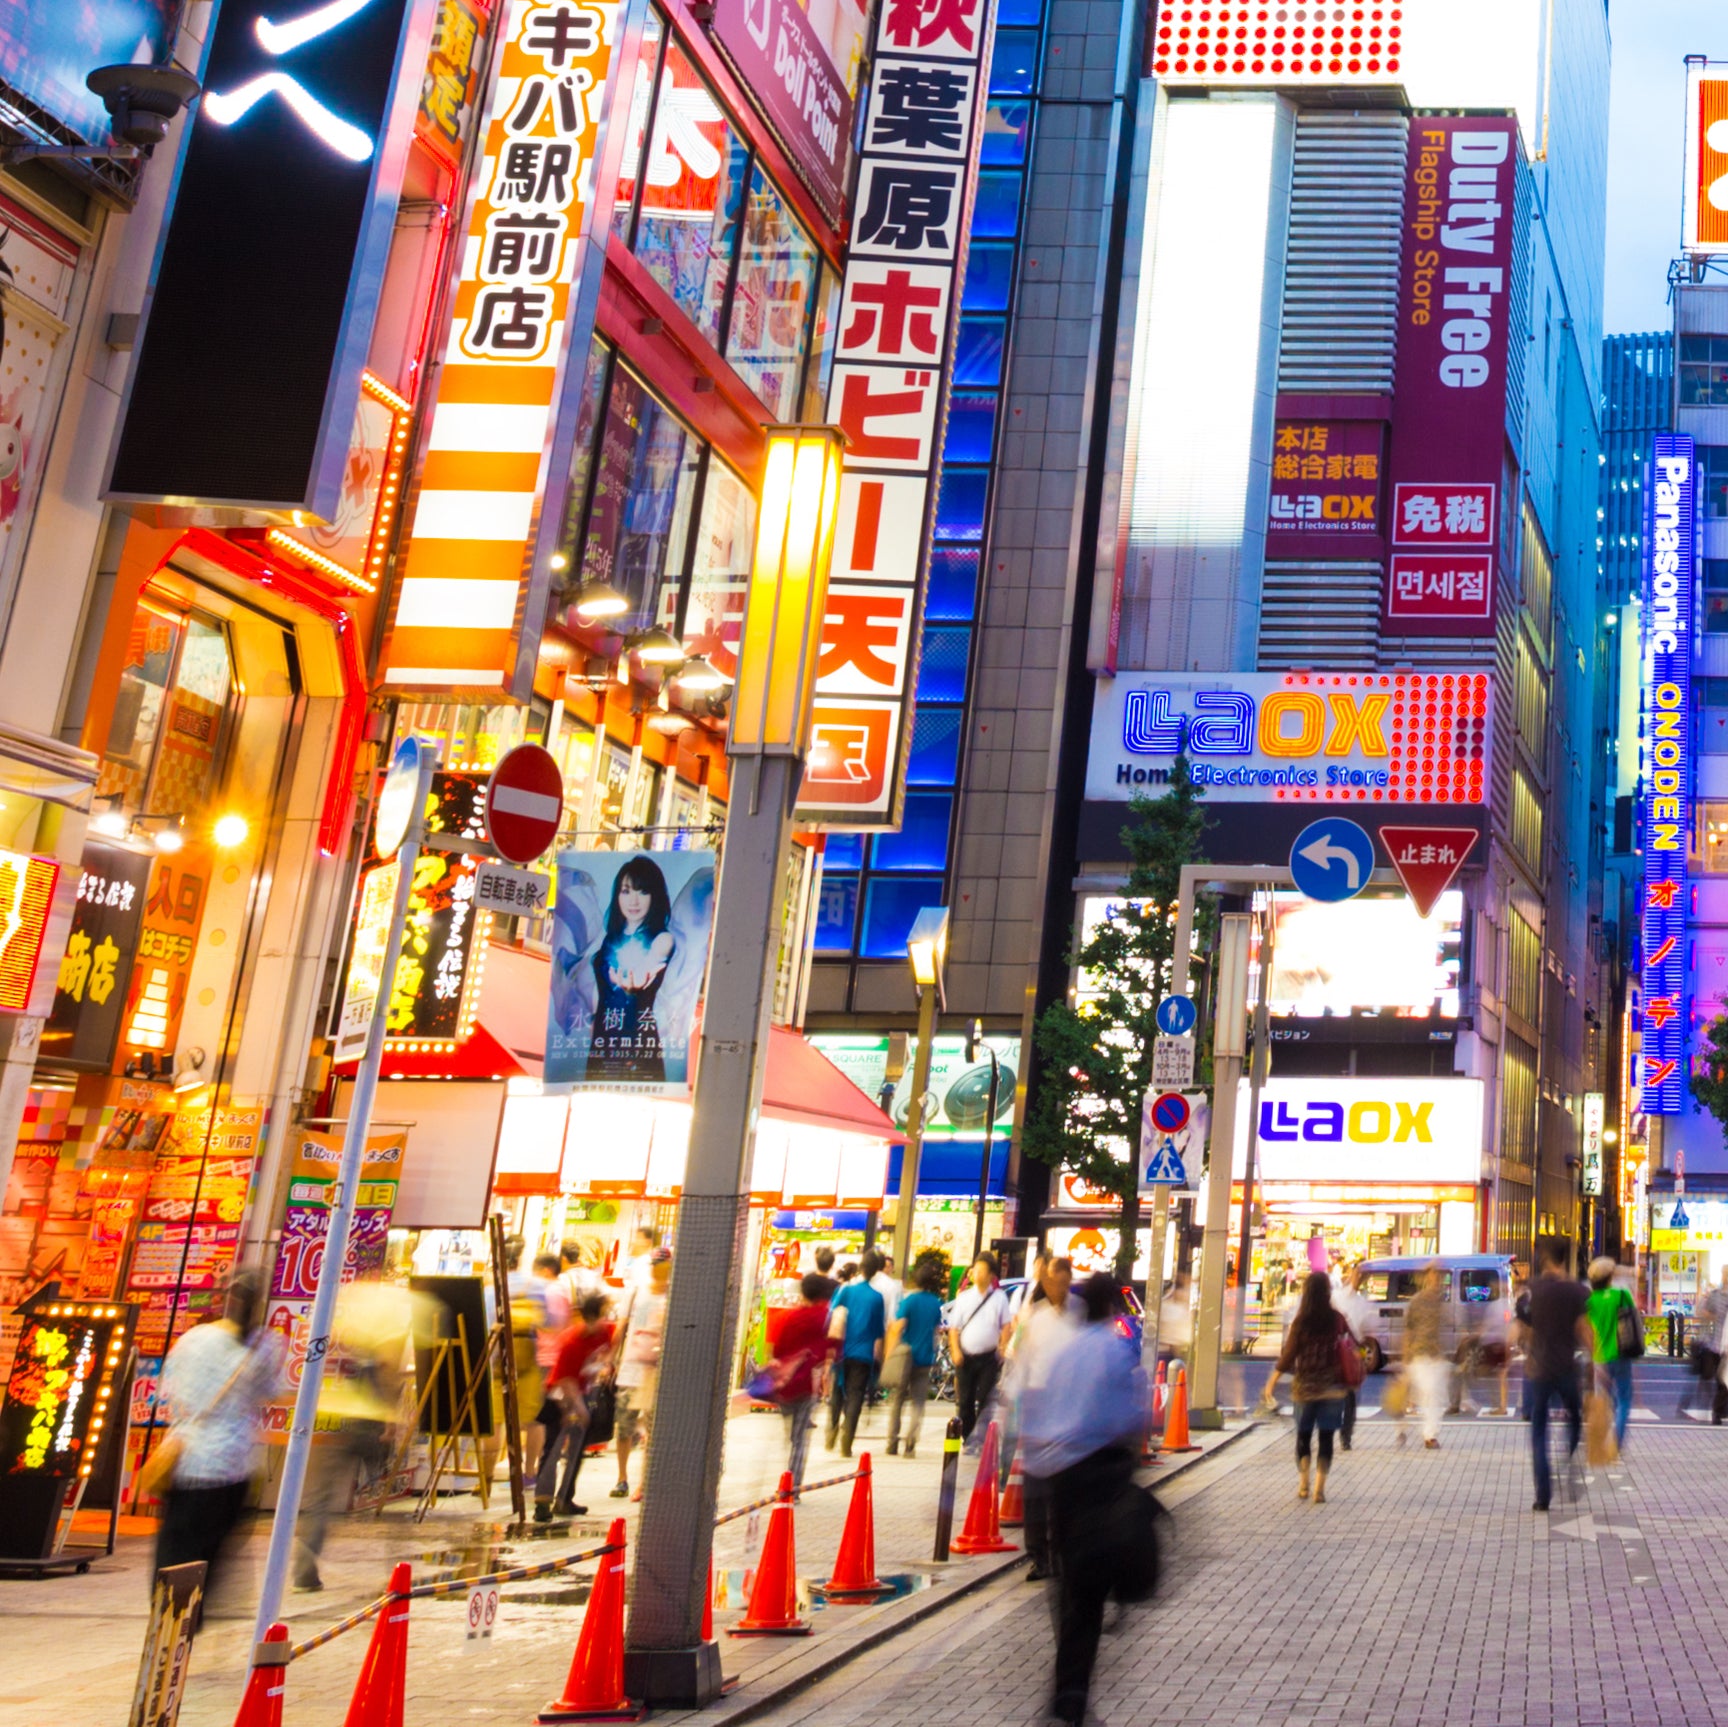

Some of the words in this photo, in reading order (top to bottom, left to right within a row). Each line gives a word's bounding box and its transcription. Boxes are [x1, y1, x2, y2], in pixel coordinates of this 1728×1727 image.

[773, 24, 806, 109] Doll
[802, 73, 840, 166] Point
[1411, 129, 1447, 242] Flagship
[1438, 130, 1511, 256] Duty
[1410, 248, 1440, 326] Store
[1438, 267, 1504, 389] Free
[1275, 426, 1330, 453] 本店
[1272, 453, 1379, 480] 総合家電
[1269, 521, 1296, 531] Home
[1303, 521, 1350, 531] Electronics
[1351, 521, 1377, 531] Store
[1401, 493, 1487, 535] 免税
[1654, 456, 1689, 655] Panasonic
[1395, 569, 1486, 602] 면세점
[1116, 764, 1176, 786] Hom
[1190, 763, 1319, 787] Electronics
[1325, 764, 1390, 787] Store
[1652, 680, 1682, 853] ONODEN
[1398, 845, 1457, 867] 止まれ
[147, 865, 204, 925] 入口
[479, 872, 547, 910] 自転車を除く
[138, 926, 193, 967] はコチラ
[1645, 878, 1682, 1088] オノデン
[569, 1006, 680, 1032] 水樹奈々
[551, 1033, 687, 1050] Exterminate
[608, 1050, 654, 1059] 2015.7.22
[832, 1054, 883, 1064] SQUARE
[138, 1224, 165, 1240] 4F
